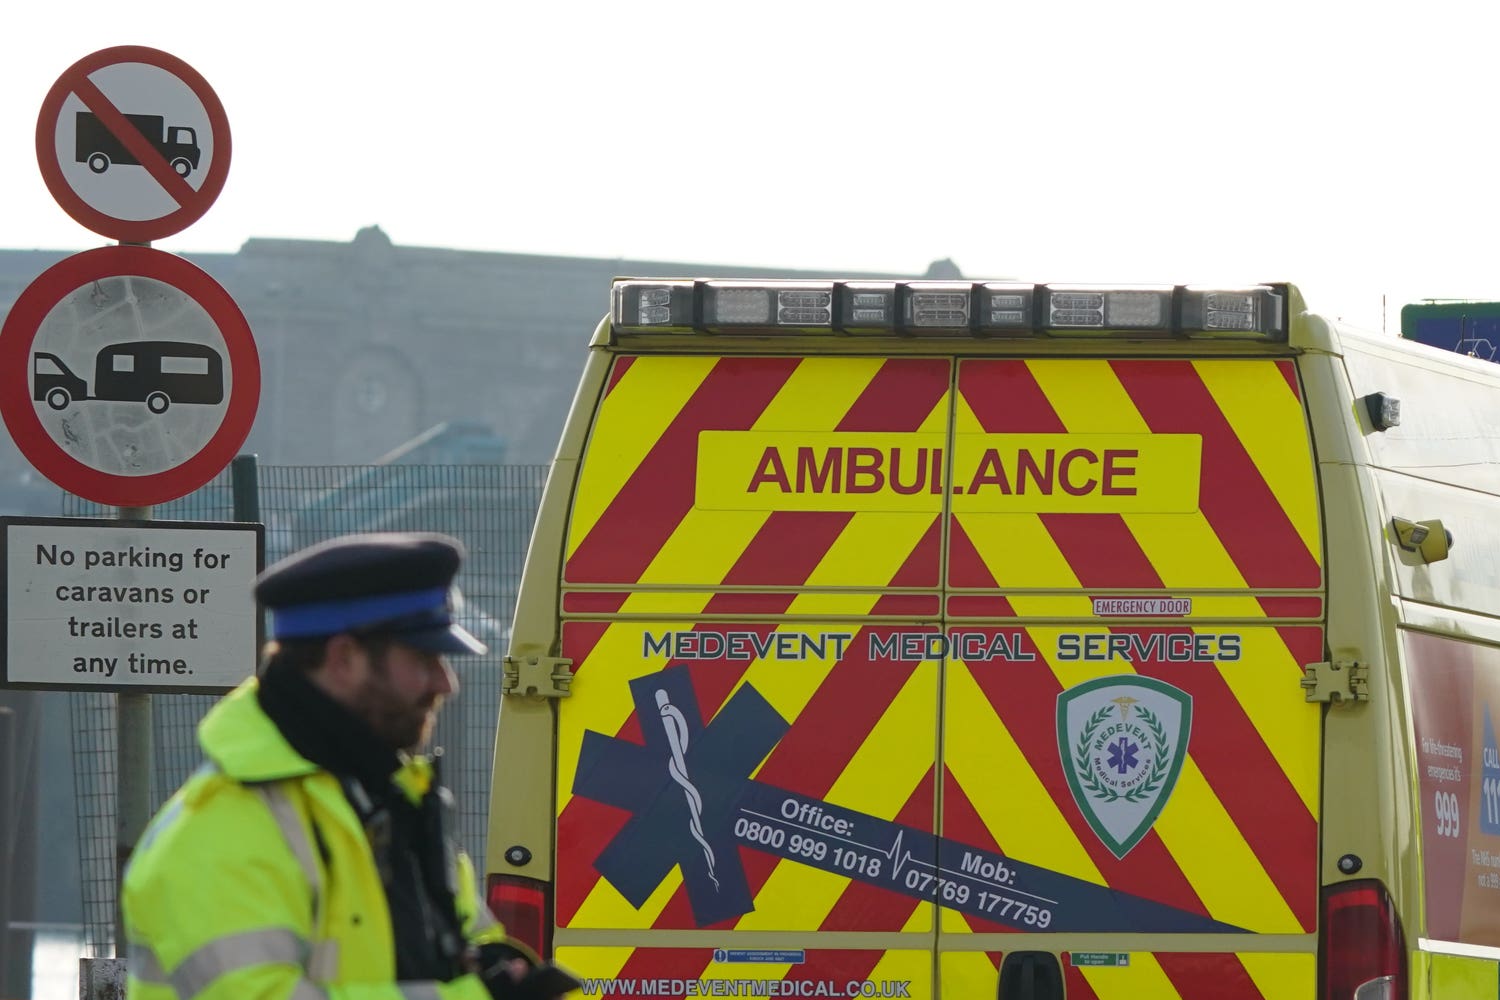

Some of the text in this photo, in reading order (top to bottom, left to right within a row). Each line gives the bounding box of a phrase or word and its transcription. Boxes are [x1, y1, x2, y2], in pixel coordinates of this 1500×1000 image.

[746, 446, 1139, 496] AMBULANCE
[36, 544, 230, 572] No parking for
[56, 585, 210, 604] caravans or
[1096, 600, 1189, 613] EMERGENCY DOOR
[68, 616, 198, 639] trailers at
[642, 631, 1241, 662] MEDEVENT MEDICAL SERVICES
[73, 653, 194, 677] any time.
[1094, 723, 1152, 751] MEDEVENT
[1094, 757, 1151, 788] Medical Services
[1483, 747, 1500, 769] CALL
[780, 798, 855, 837] Office:
[1435, 791, 1460, 838] 999
[734, 817, 881, 878] 0800 999 1018
[960, 851, 1016, 885] Mob:
[905, 869, 1052, 929] 07769 177759
[581, 978, 911, 998] WWW.MEDEVENTMEDICAL.CO.UK
